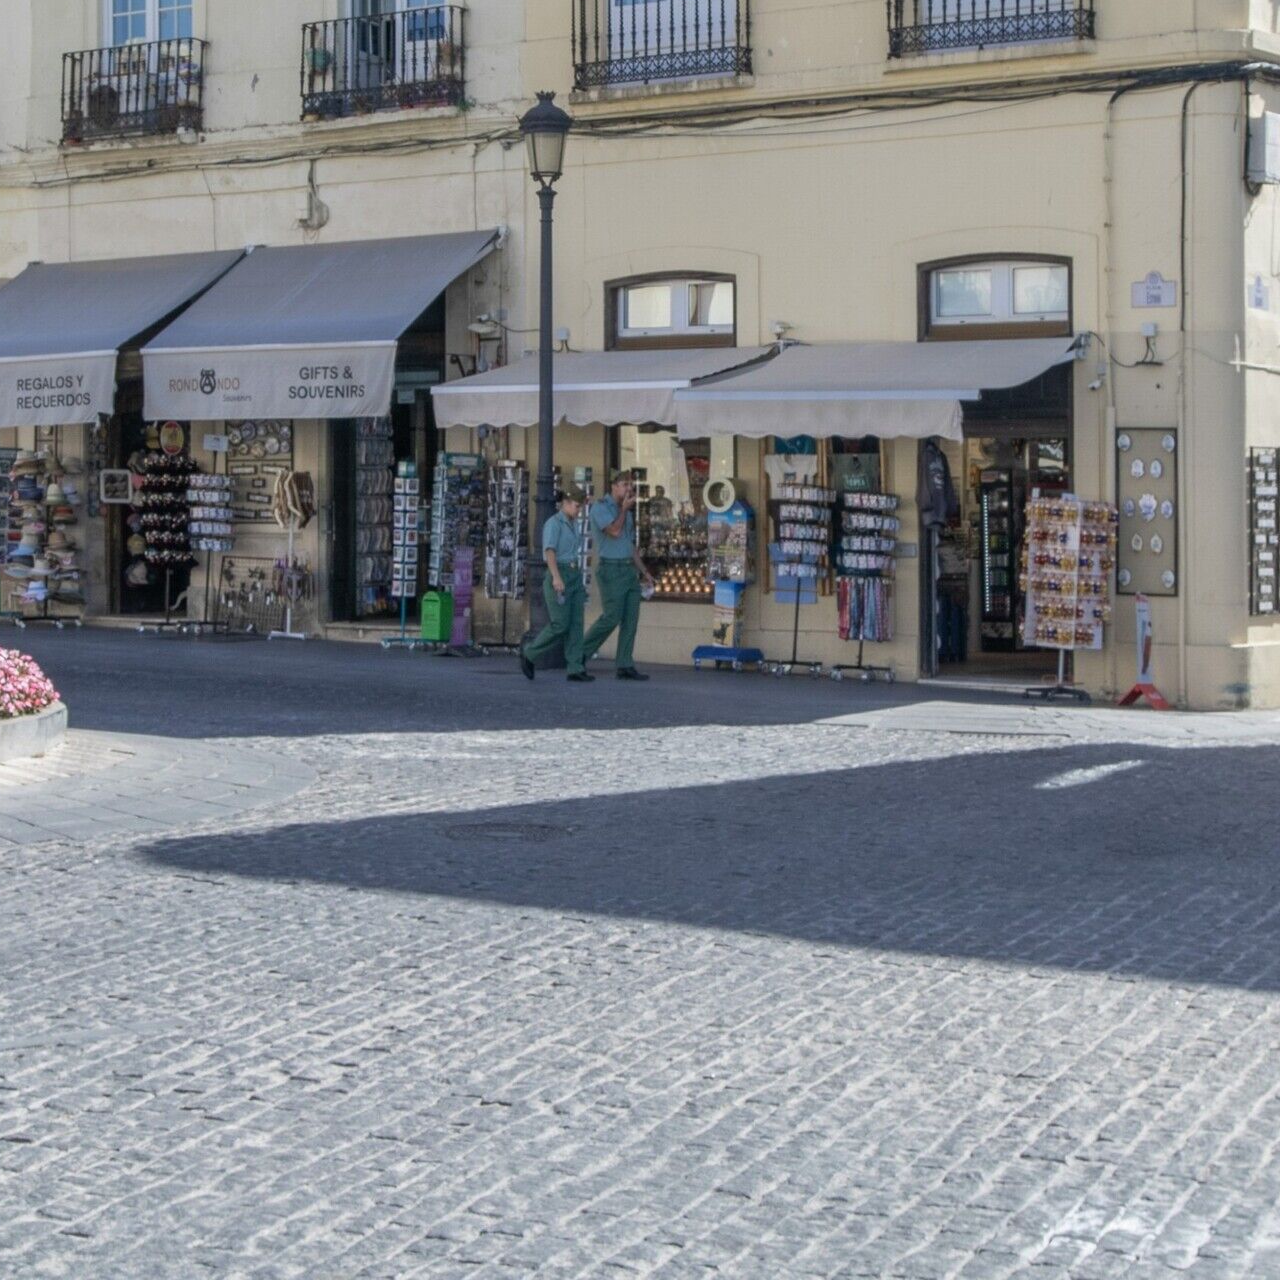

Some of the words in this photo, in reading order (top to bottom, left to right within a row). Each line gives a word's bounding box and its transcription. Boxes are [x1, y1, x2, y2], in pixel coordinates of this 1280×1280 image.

[299, 366, 338, 381] GIFTS
[343, 366, 354, 380] &
[16, 375, 73, 392] REGALOS
[76, 375, 84, 388] Y
[288, 385, 365, 400] SOUVENIRS
[16, 393, 92, 410] RECUERDOS
